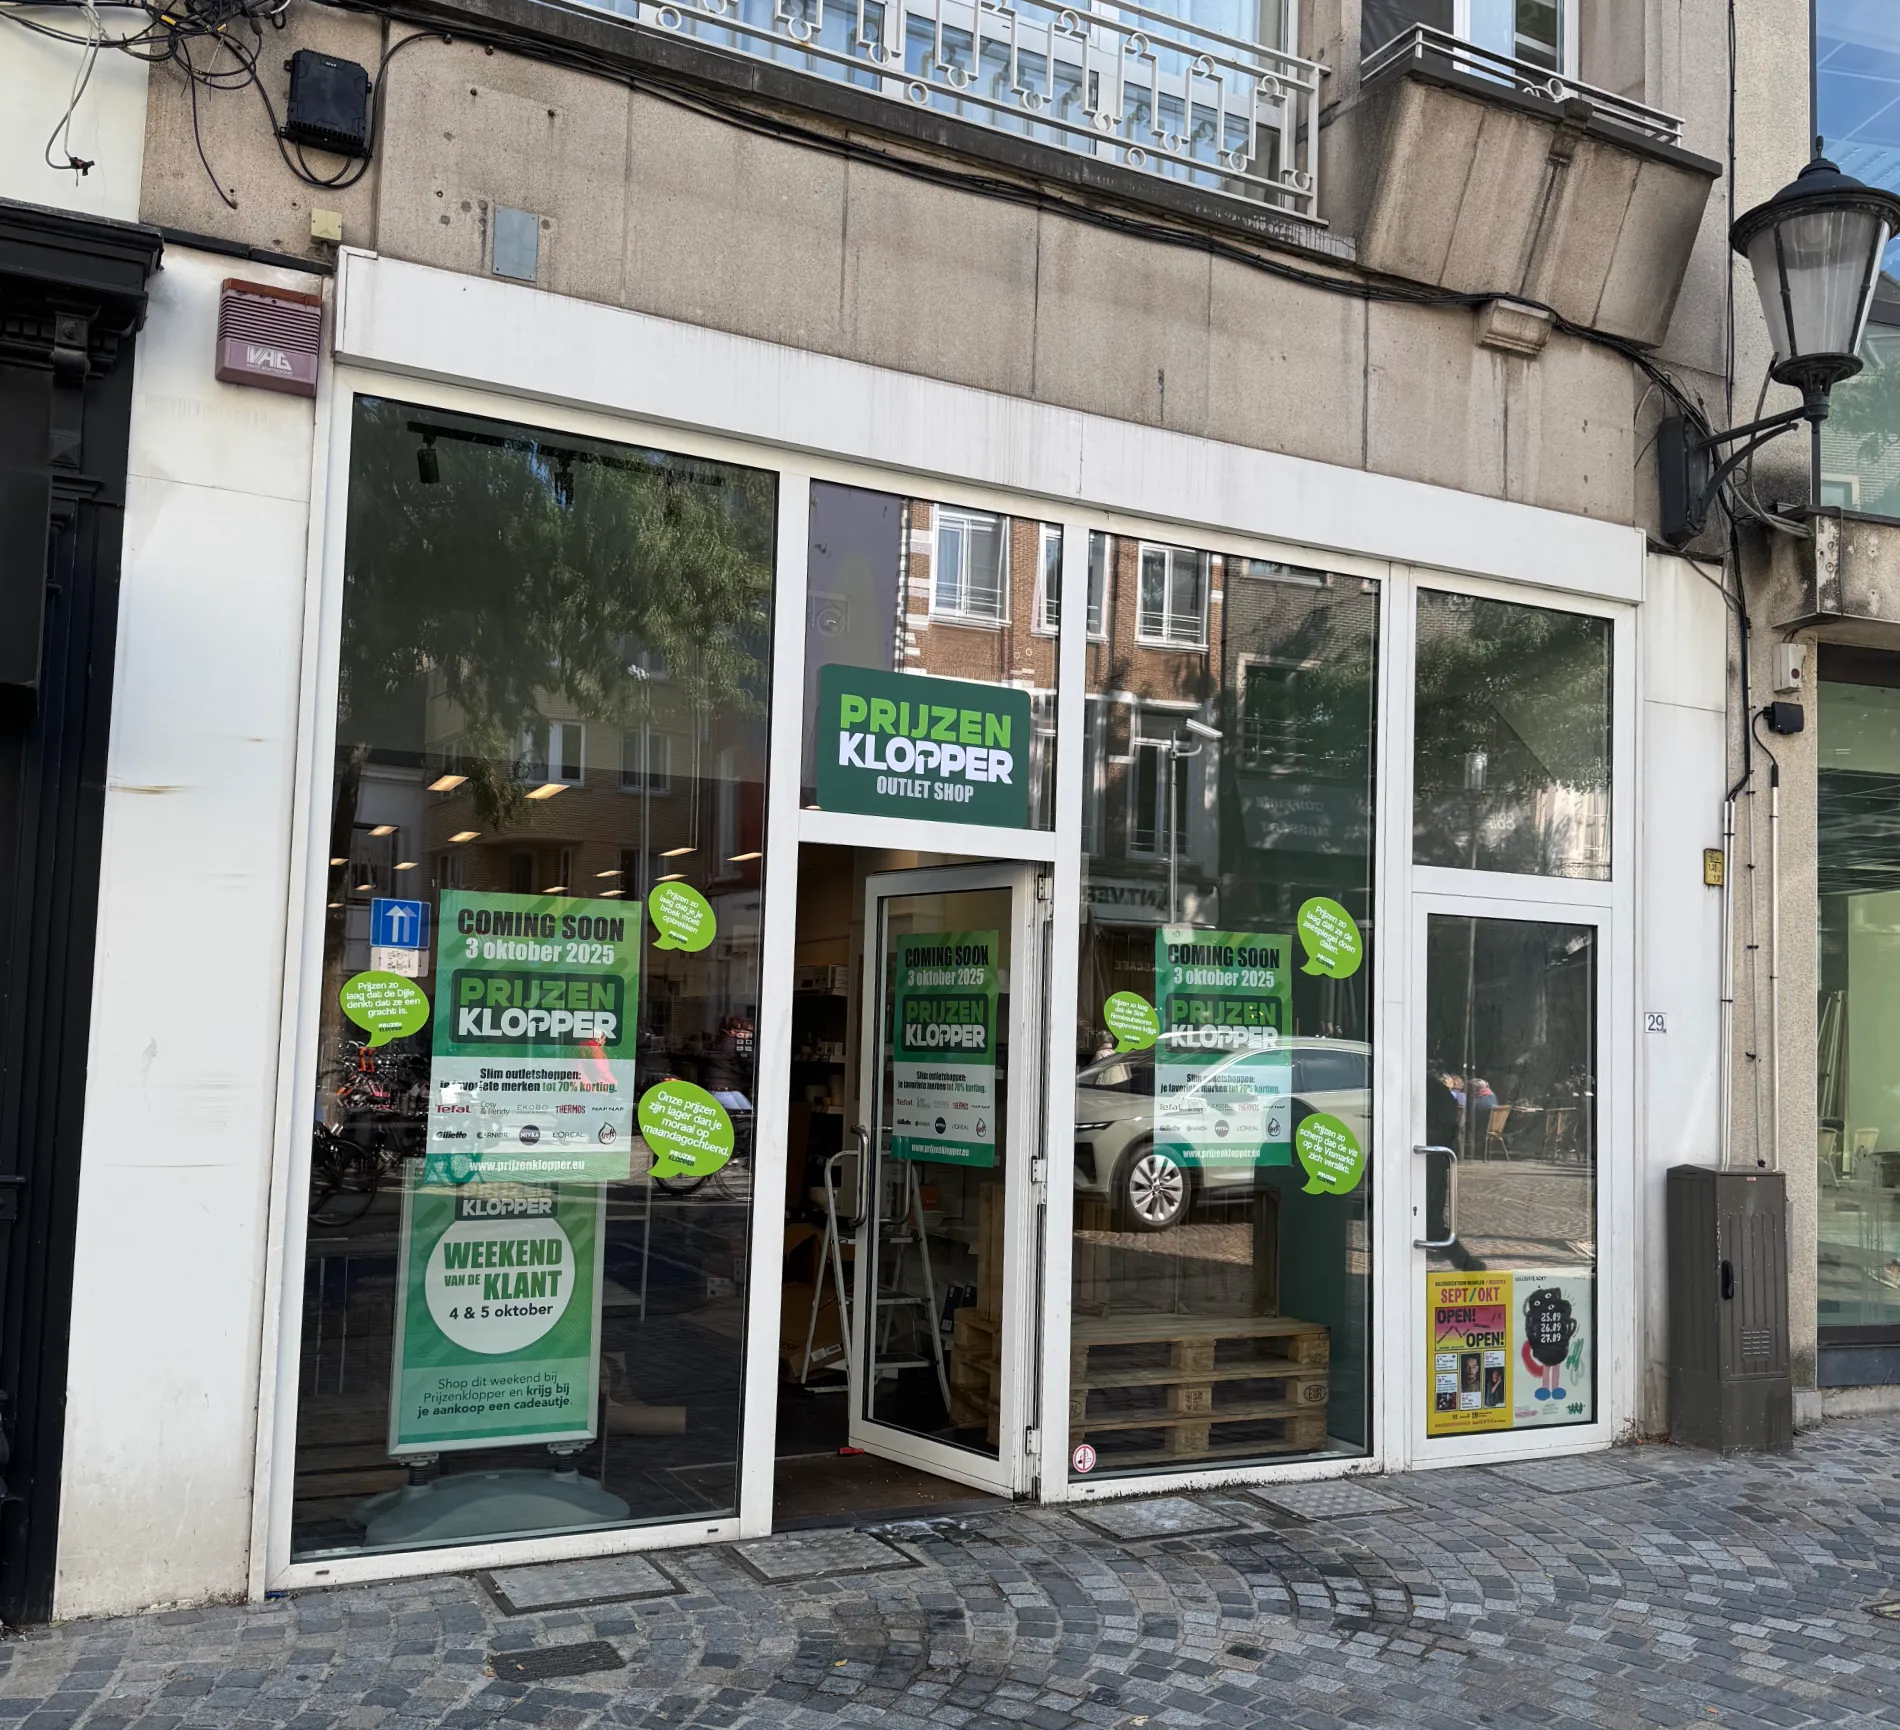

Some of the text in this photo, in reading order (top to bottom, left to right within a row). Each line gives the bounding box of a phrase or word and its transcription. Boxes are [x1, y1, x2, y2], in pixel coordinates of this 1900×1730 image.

[247, 345, 292, 370] VAG
[840, 693, 1012, 749] PRIJZEN
[838, 730, 1014, 785] KLOPPER
[876, 775, 974, 803] OUTLET SHOP
[659, 895, 674, 908] laag
[686, 909, 695, 917] je
[694, 910, 703, 919] je
[666, 889, 699, 908] Prijzen zo
[457, 908, 624, 942] COMING SOON
[1306, 911, 1352, 942] laag dat ze de
[1315, 906, 1347, 928] Prijzen zo
[1303, 921, 1356, 954] zeespiegel doen
[465, 937, 615, 965] 3 oktober 2025
[905, 945, 989, 968] COMING SOON
[1168, 944, 1234, 967] COMING
[1238, 947, 1280, 969] SOON
[358, 982, 387, 991] Prijzen
[908, 968, 984, 987] 3 oktober 2025
[1174, 967, 1275, 988] 3 oktober 2025
[346, 989, 415, 1001] laag dat de Dijle
[347, 1000, 373, 1009] denkt
[375, 999, 390, 1007] dat
[460, 977, 616, 1010] PRIJZEN
[368, 1007, 408, 1019] gracht is.
[458, 1007, 617, 1039] KLOPPER
[906, 1001, 984, 1023] PRIJZEN
[1172, 1000, 1277, 1025] PRIJZEN
[1648, 1014, 1664, 1032] 29
[905, 1023, 986, 1048] KLOPPER
[1171, 1024, 1279, 1049] KLOPPER
[480, 1068, 582, 1081] Slim outletshoppen:
[501, 1082, 540, 1092] merken
[542, 1082, 556, 1092] tot
[558, 1082, 578, 1092] 70%
[580, 1082, 617, 1093] korting.
[435, 1104, 472, 1114] Tefal
[555, 1105, 586, 1114] THERMOS
[658, 1091, 716, 1116] Onze prijzen
[648, 1101, 722, 1131] zijn lager dan je
[643, 1124, 729, 1157] maandagochtend.
[662, 1118, 710, 1141] moraal op
[1314, 1122, 1345, 1142] Prijzen zo
[1299, 1128, 1358, 1157] scherp dat de vis
[1302, 1140, 1355, 1166] op de Vismarkt
[470, 1160, 585, 1172] www.prijzenklopper.eu
[1308, 1152, 1323, 1163] zich
[462, 1197, 552, 1216] KLOPPER
[444, 1239, 563, 1270] WEEKEND
[444, 1270, 563, 1301] VAN DE KLANT
[449, 1303, 554, 1320] 4 & 5 oktober
[1437, 1309, 1476, 1325] OPEN!
[1541, 1312, 1561, 1322] 25.09
[1541, 1323, 1561, 1332] 26.09
[1541, 1333, 1561, 1344] 27.09
[1466, 1332, 1504, 1348] OPEN!
[438, 1371, 557, 1390] Shop dit weekend bij
[423, 1382, 570, 1405] Prijzenklopper en krijg bij
[1308, 1388, 1322, 1399] EUR
[417, 1397, 573, 1420] je aankoop een cadeautje.
